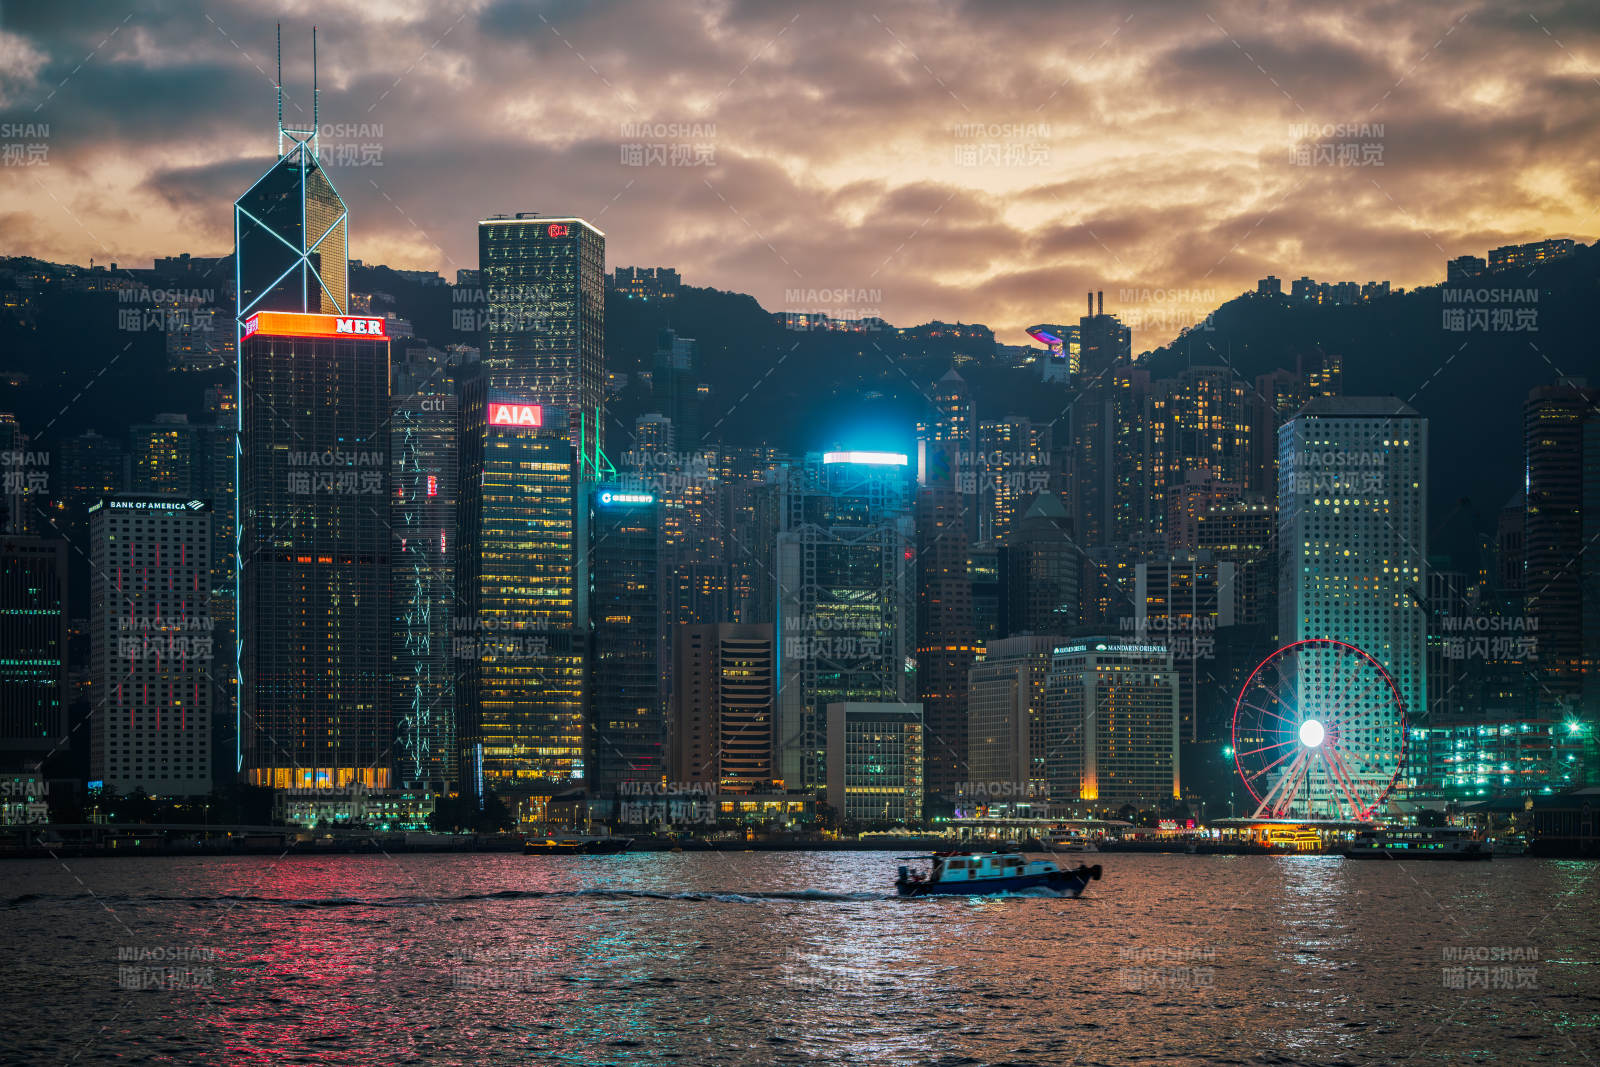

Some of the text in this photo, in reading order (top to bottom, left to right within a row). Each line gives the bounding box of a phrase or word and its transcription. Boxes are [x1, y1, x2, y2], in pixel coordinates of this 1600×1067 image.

[336, 319, 383, 334] MER
[421, 398, 445, 411] citi
[495, 406, 535, 424] AIA
[148, 502, 186, 510] AMERICA
